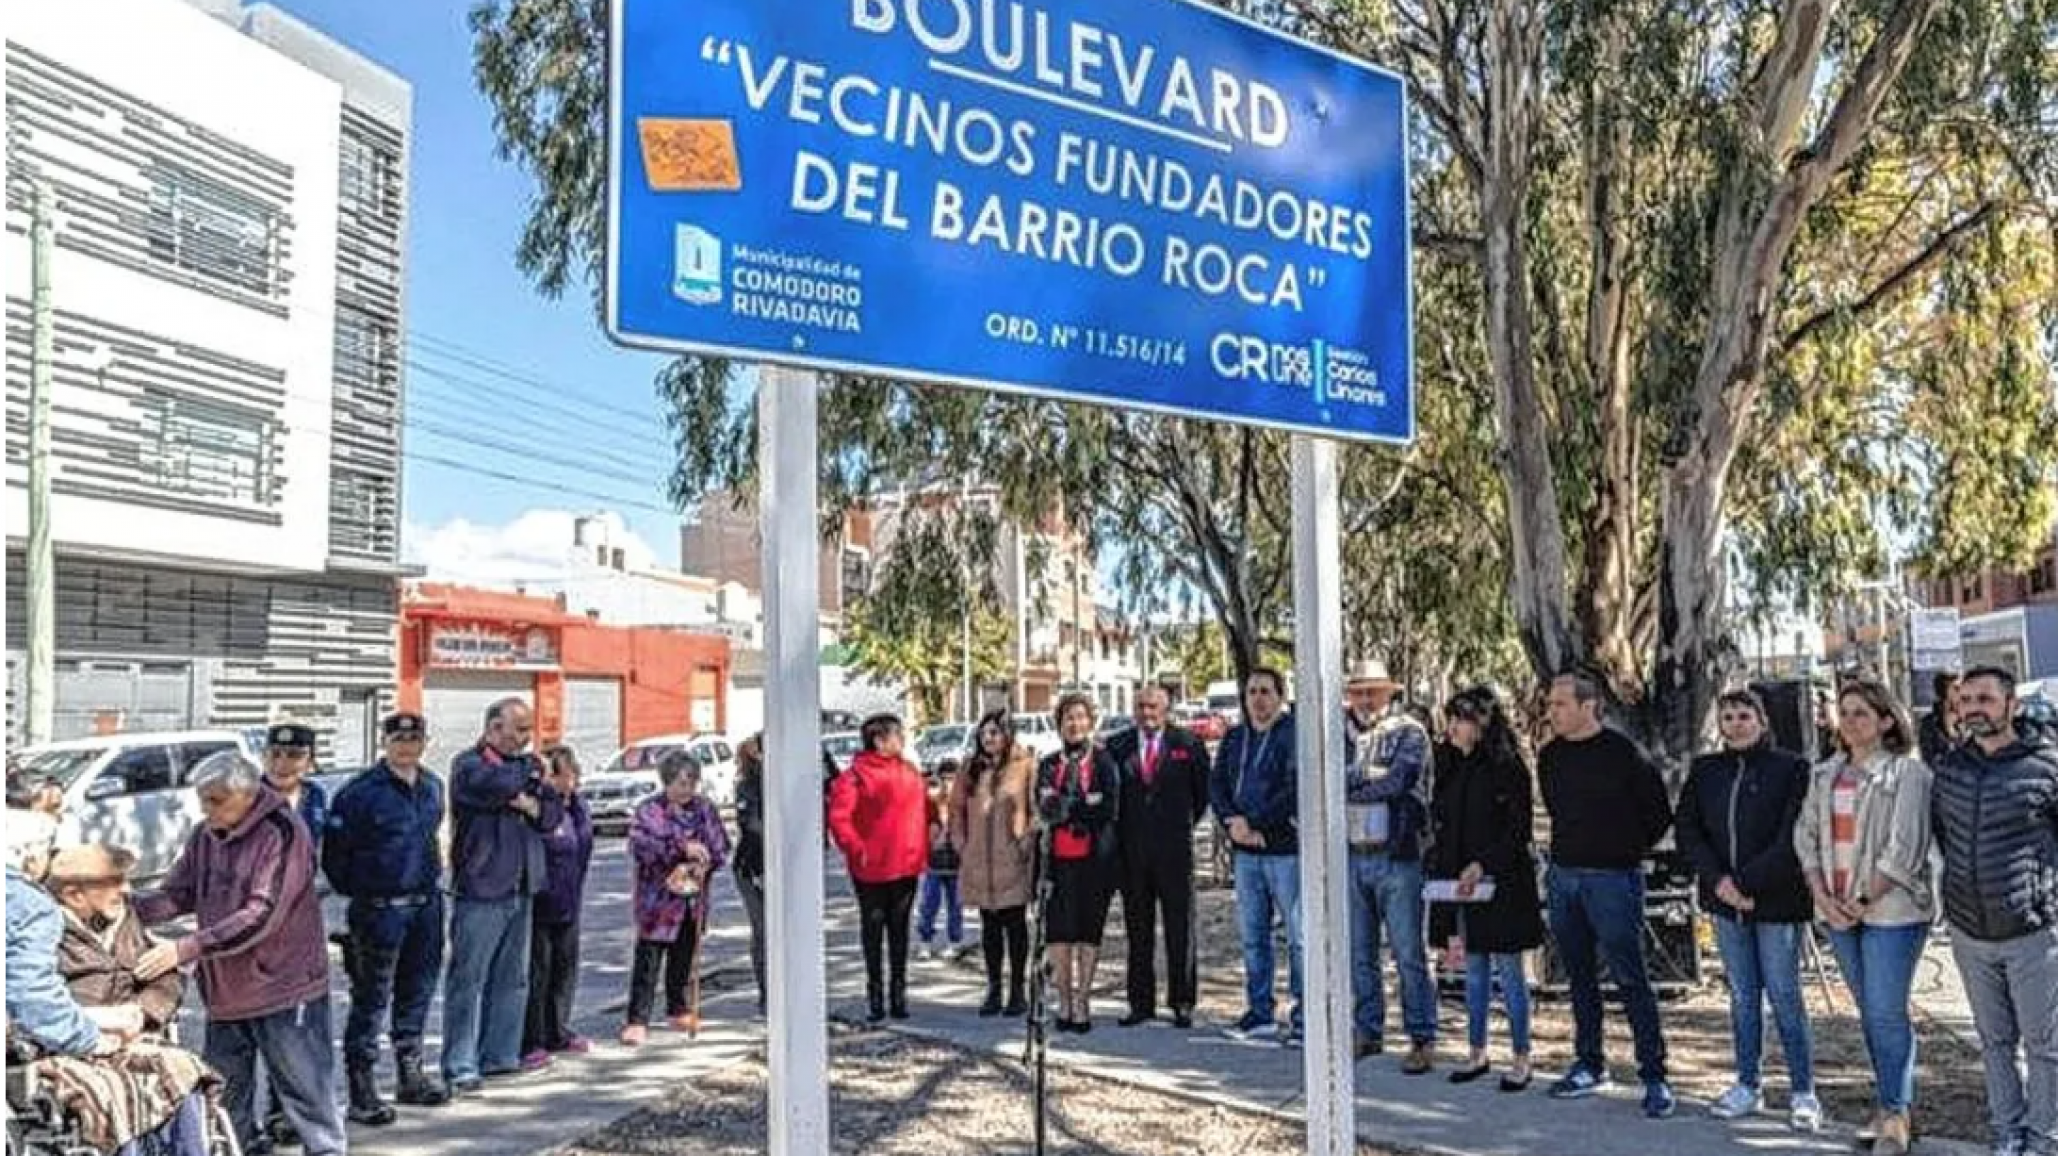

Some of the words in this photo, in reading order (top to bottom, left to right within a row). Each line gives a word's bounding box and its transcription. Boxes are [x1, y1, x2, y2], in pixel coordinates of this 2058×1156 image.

[701, 36, 1036, 176] “VECINOS
[1055, 131, 1373, 260] FUNDADORES
[791, 149, 909, 230] DEL
[931, 181, 1144, 276] BARRIO
[1162, 236, 1326, 312] ROCA”
[732, 265, 862, 308] COMODORO
[843, 263, 862, 281] de
[732, 291, 862, 334] RIVADAVIA
[985, 312, 1044, 345] ORD.
[1085, 328, 1187, 367] 11.516/14
[1211, 332, 1269, 382] CR
[1326, 359, 1378, 387] Carlos
